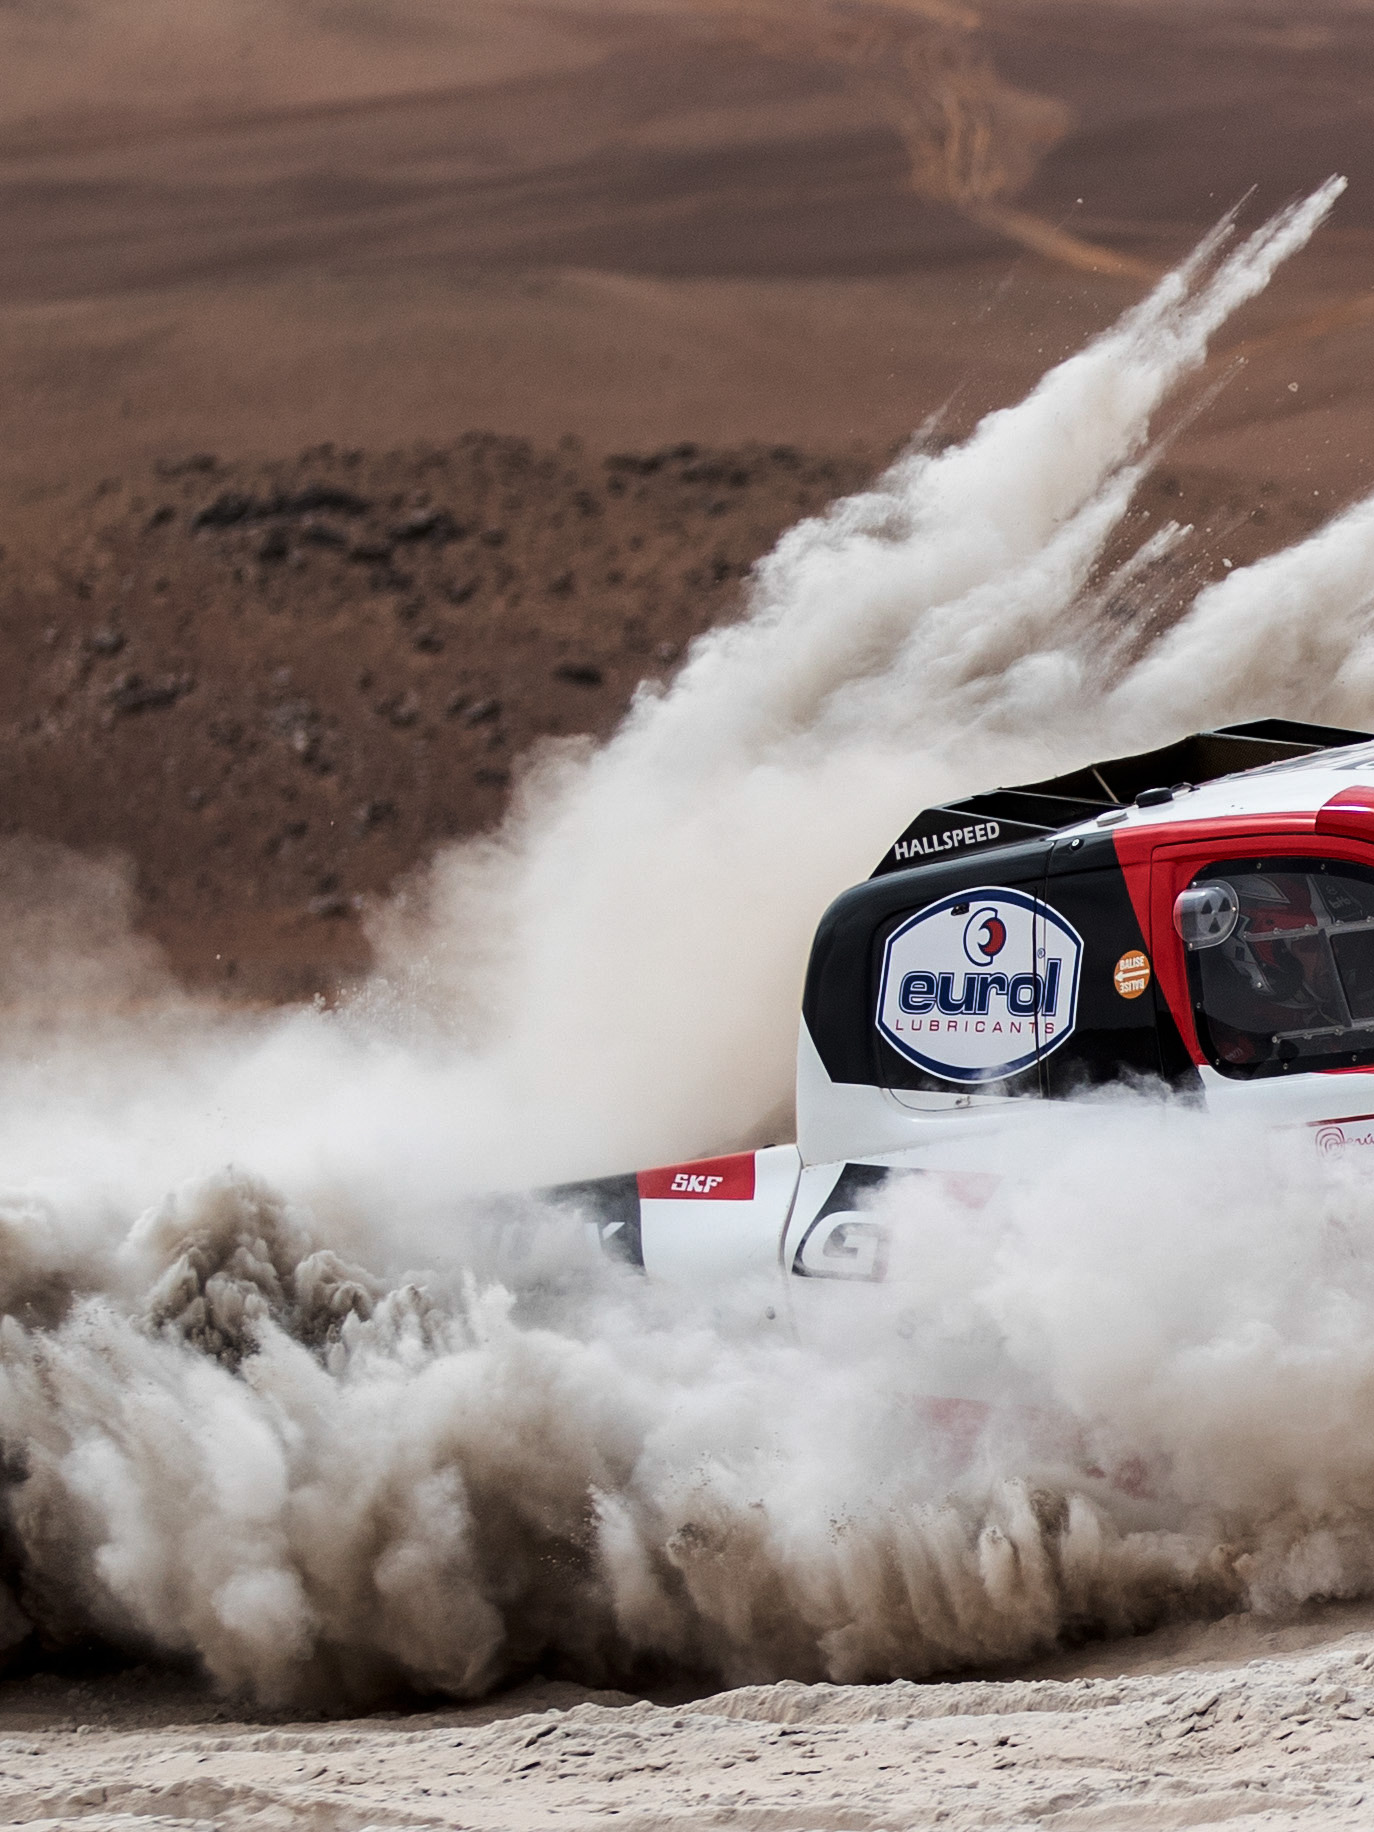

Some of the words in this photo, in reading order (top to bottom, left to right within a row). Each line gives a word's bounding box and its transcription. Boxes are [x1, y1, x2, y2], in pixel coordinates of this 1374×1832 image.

[894, 821, 1000, 860] HALLSPEED
[1119, 955, 1145, 971] BALISE
[899, 957, 1062, 1017] eurol
[895, 1018, 1056, 1035] LUBRICANTS
[671, 1173, 723, 1195] SKF
